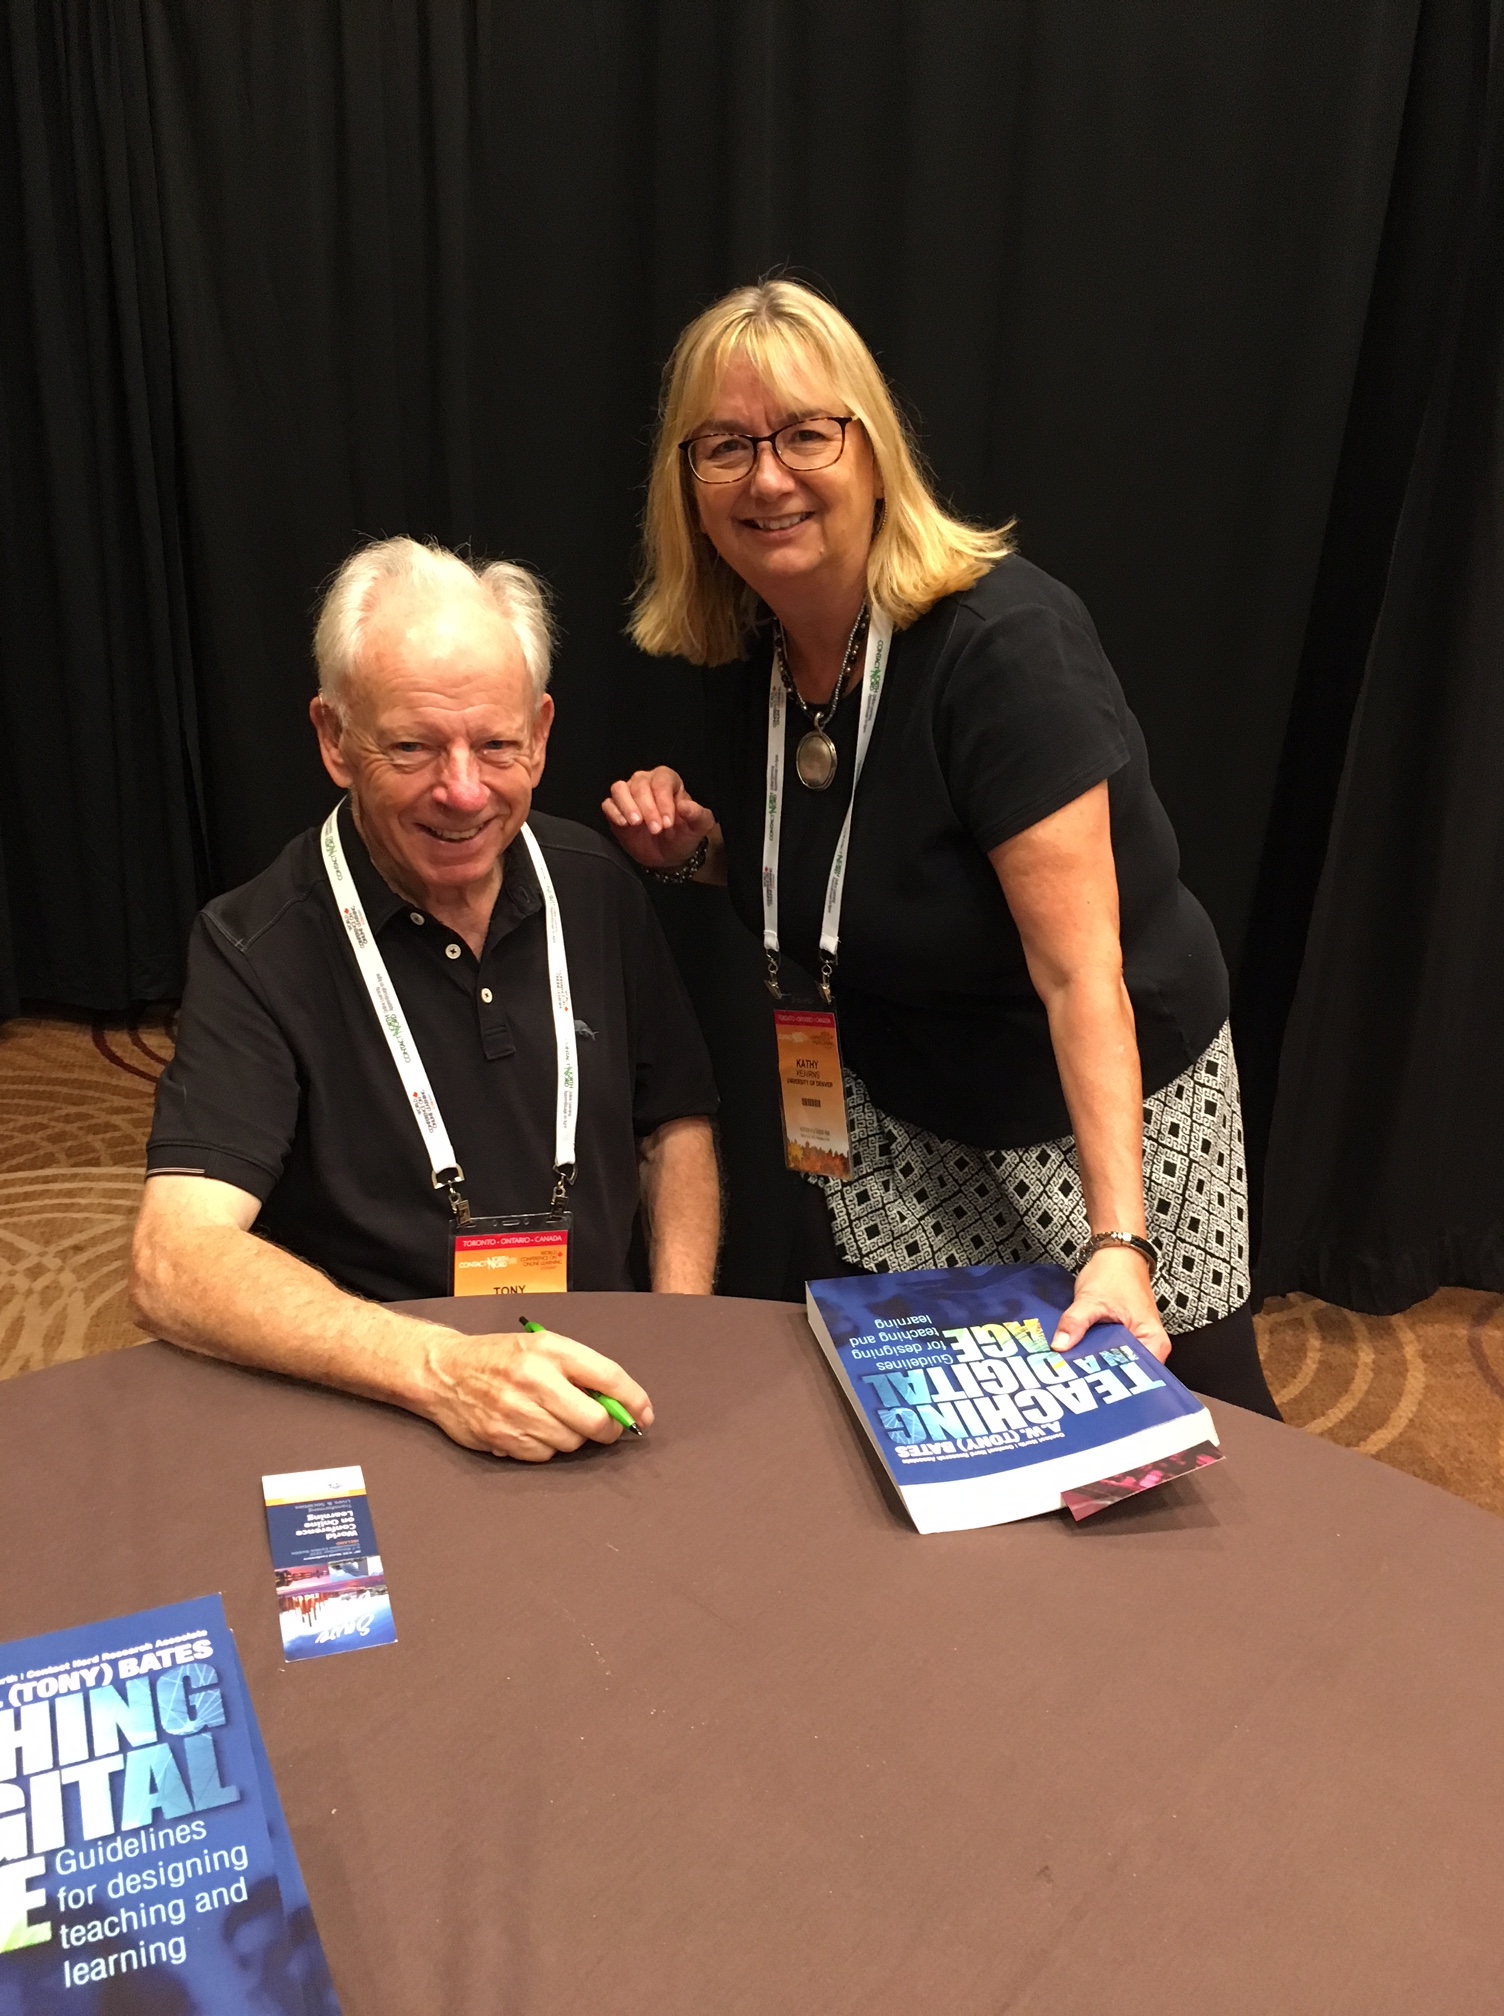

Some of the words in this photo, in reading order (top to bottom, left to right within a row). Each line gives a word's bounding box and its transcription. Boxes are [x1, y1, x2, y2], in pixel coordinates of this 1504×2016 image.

[396, 1034, 411, 1063] CONTACT
[796, 1059, 818, 1069] KATHY
[463, 1239, 496, 1247] TORONTO
[501, 1237, 530, 1245] ONTARIO
[493, 1285, 526, 1295] TONY
[874, 1315, 932, 1329] learning
[849, 1334, 876, 1348] and
[881, 1326, 940, 1339] teaching
[942, 1318, 1051, 1363] AGE
[852, 1344, 927, 1360] designing
[932, 1340, 946, 1350] for
[876, 1354, 954, 1371] Guidelines
[1073, 1354, 1101, 1374] A
[1099, 1345, 1139, 1367] IN
[861, 1351, 1079, 1408] DIGITAL
[877, 1361, 1167, 1444] TEACHING
[894, 1441, 957, 1458] BATES
[956, 1430, 1020, 1452] (TONY)
[303, 1518, 339, 1528] Online
[306, 1509, 353, 1521] Learning
[295, 1523, 356, 1536] Conference
[325, 1529, 357, 1540] World
[8, 1662, 113, 1707] (TONY)
[118, 1639, 214, 1679] BATES
[27, 1662, 70, 1679] Contact
[55, 1819, 207, 1875] Guidelines
[58, 1884, 97, 1912] for
[107, 1845, 248, 1899] designing
[60, 1898, 186, 1949] teaching
[195, 1876, 248, 1913] and
[64, 1936, 187, 1988] learning
